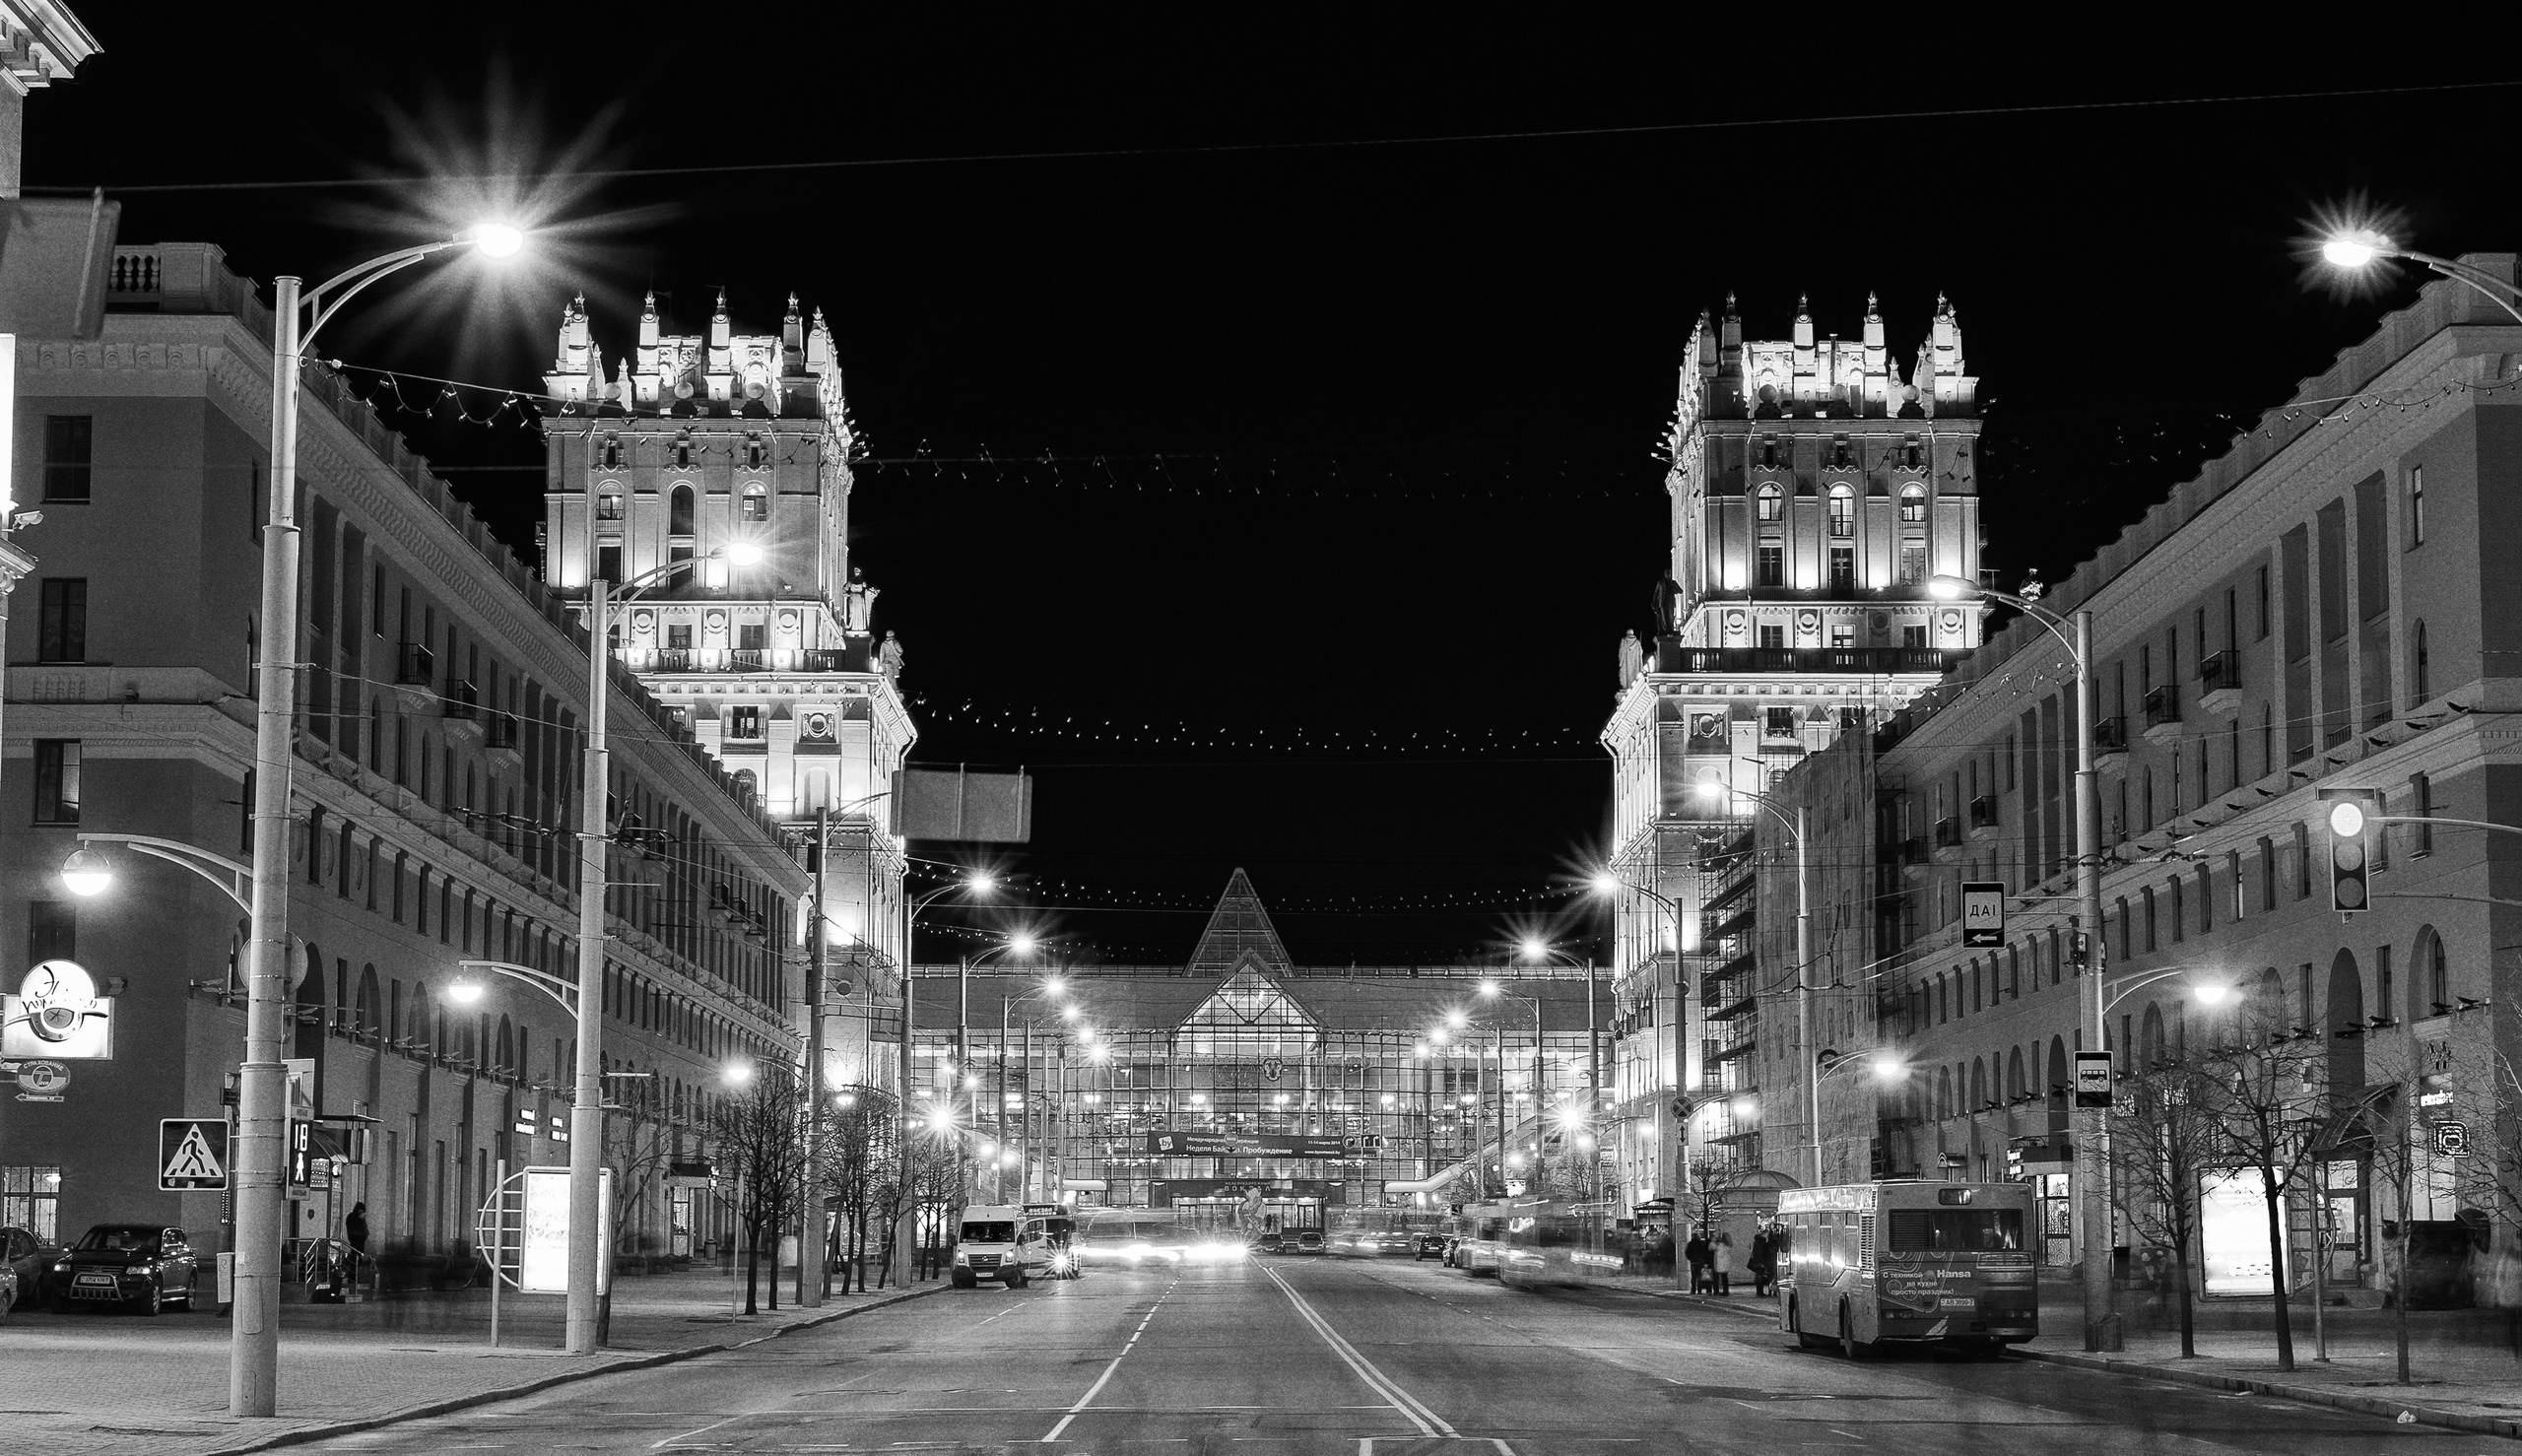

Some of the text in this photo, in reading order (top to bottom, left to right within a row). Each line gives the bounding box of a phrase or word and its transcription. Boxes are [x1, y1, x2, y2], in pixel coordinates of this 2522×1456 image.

[23, 1059, 65, 1072] СТРАХОВАНИЕ
[295, 1123, 308, 1152] 18
[1186, 1144, 1212, 1153] Неделя
[1243, 1146, 1294, 1156] Пробуждение
[1936, 1269, 1971, 1279] Hansa
[1917, 1288, 1955, 1296] праздник!
